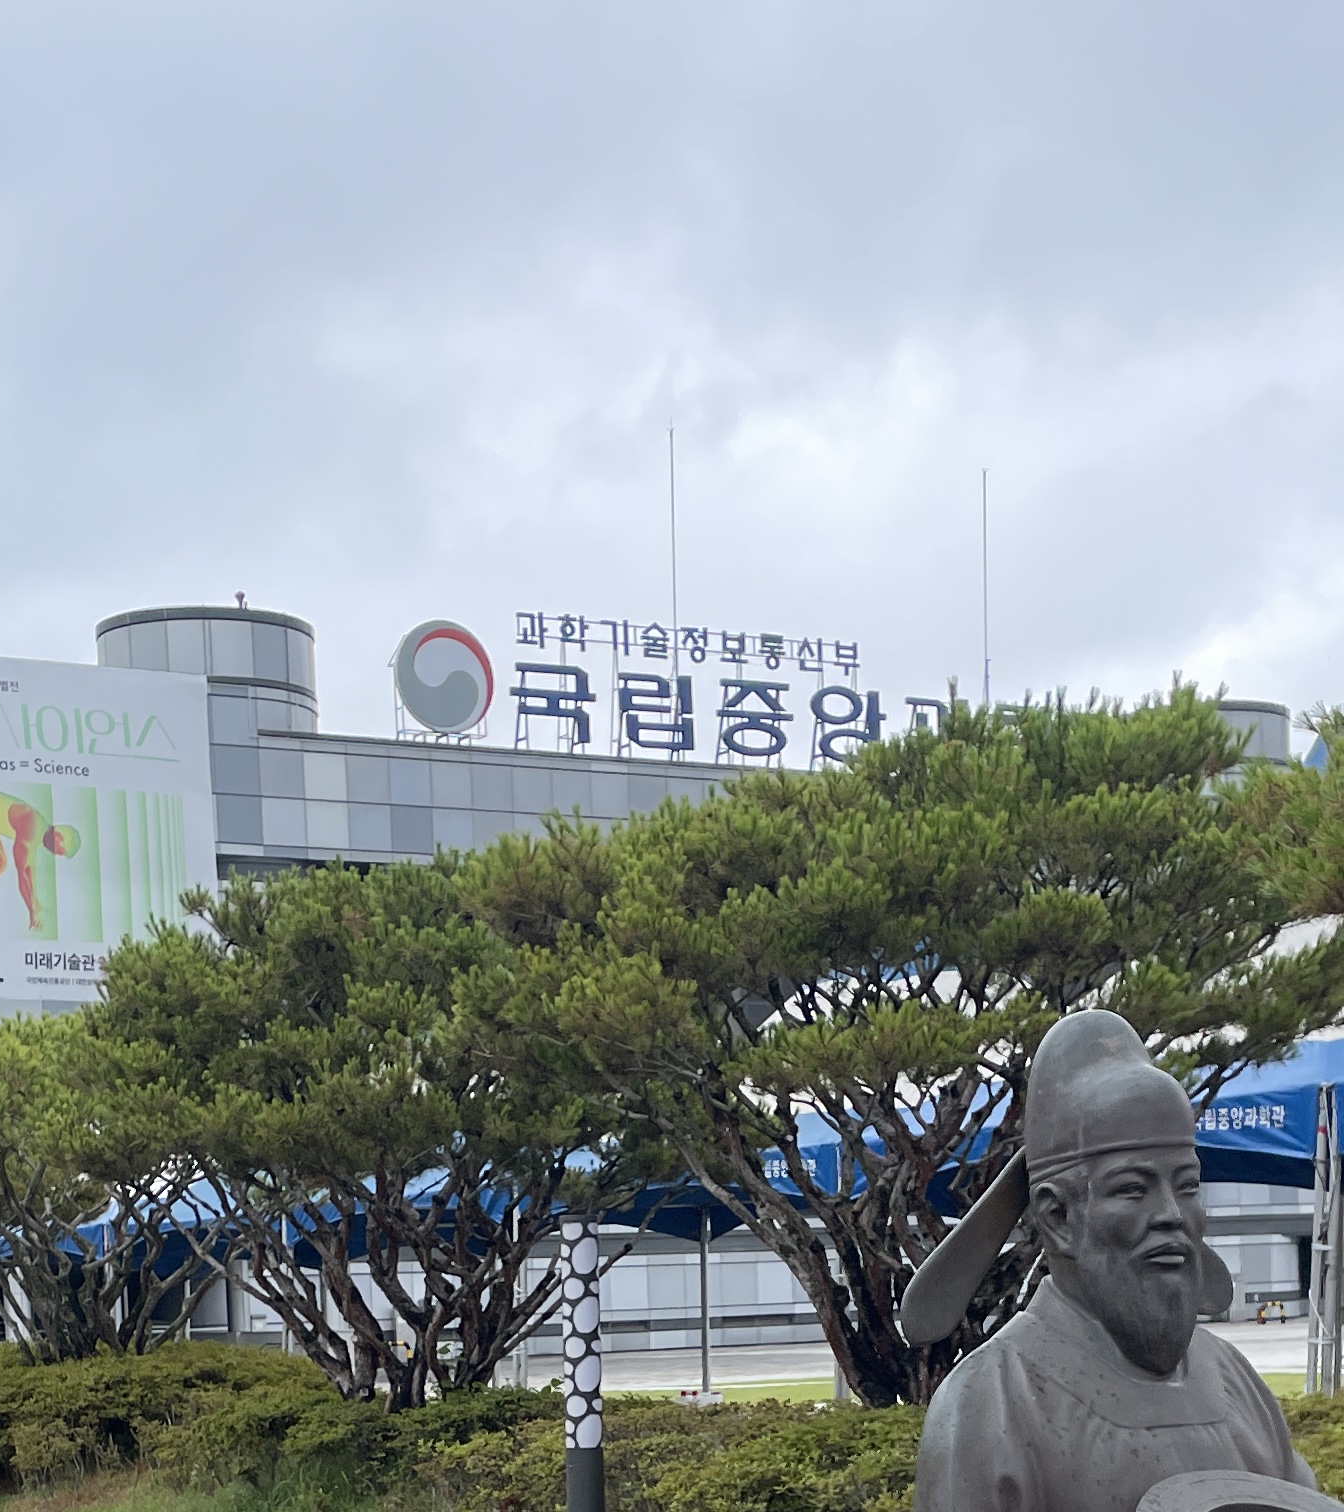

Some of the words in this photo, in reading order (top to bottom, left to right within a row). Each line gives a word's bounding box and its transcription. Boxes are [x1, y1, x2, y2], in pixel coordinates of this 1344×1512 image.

[514, 611, 861, 675] 과학기술정보통신부
[510, 662, 968, 763] 국립중앙
[34, 758, 90, 777] Science
[25, 952, 96, 971] 미래기술관
